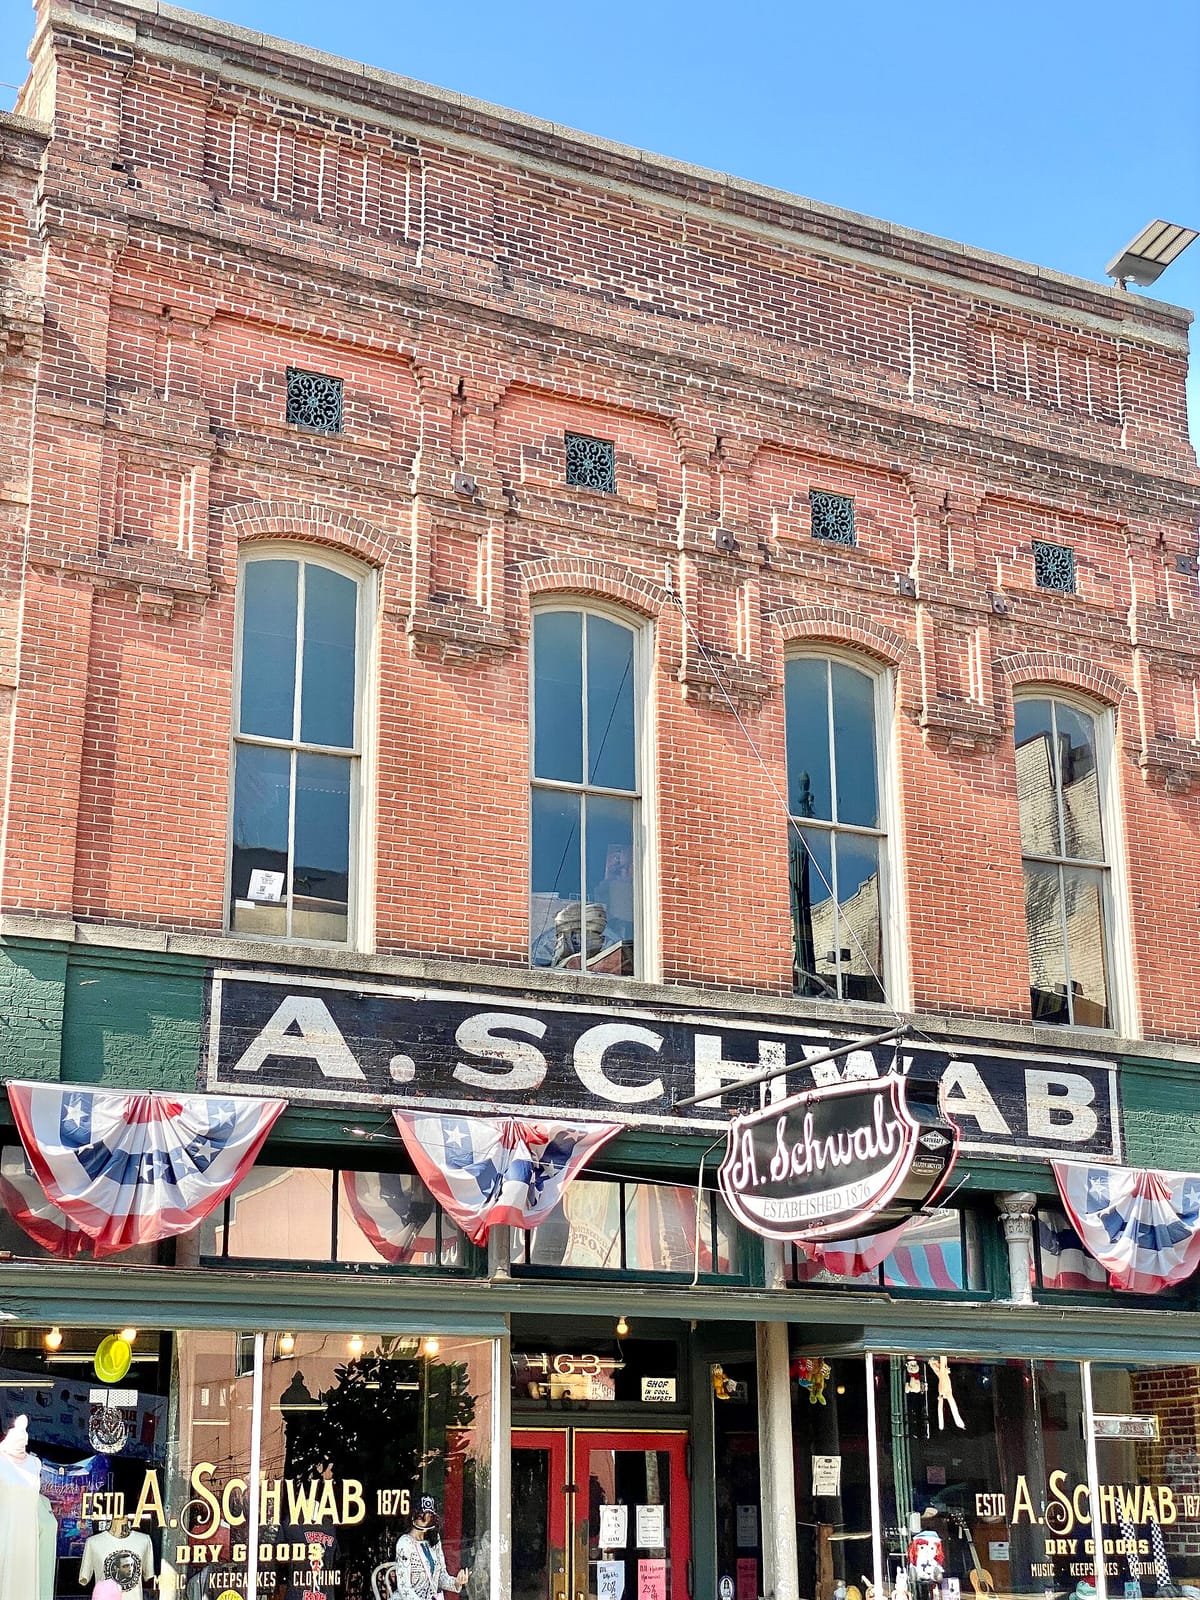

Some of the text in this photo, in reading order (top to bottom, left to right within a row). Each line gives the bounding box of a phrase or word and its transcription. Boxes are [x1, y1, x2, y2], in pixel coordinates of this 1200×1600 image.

[763, 1183, 871, 1219] ESTABLISHED 1876
[541, 1352, 602, 1376] 163
[81, 1492, 125, 1520] ESTD
[376, 1489, 410, 1515] 1876
[975, 1493, 1006, 1517] ESTD
[176, 1542, 323, 1564] DRY GOODS
[1045, 1539, 1149, 1555] DRY GOODS
[1031, 1563, 1055, 1577] MUSIC
[153, 1574, 187, 1590] MIC
